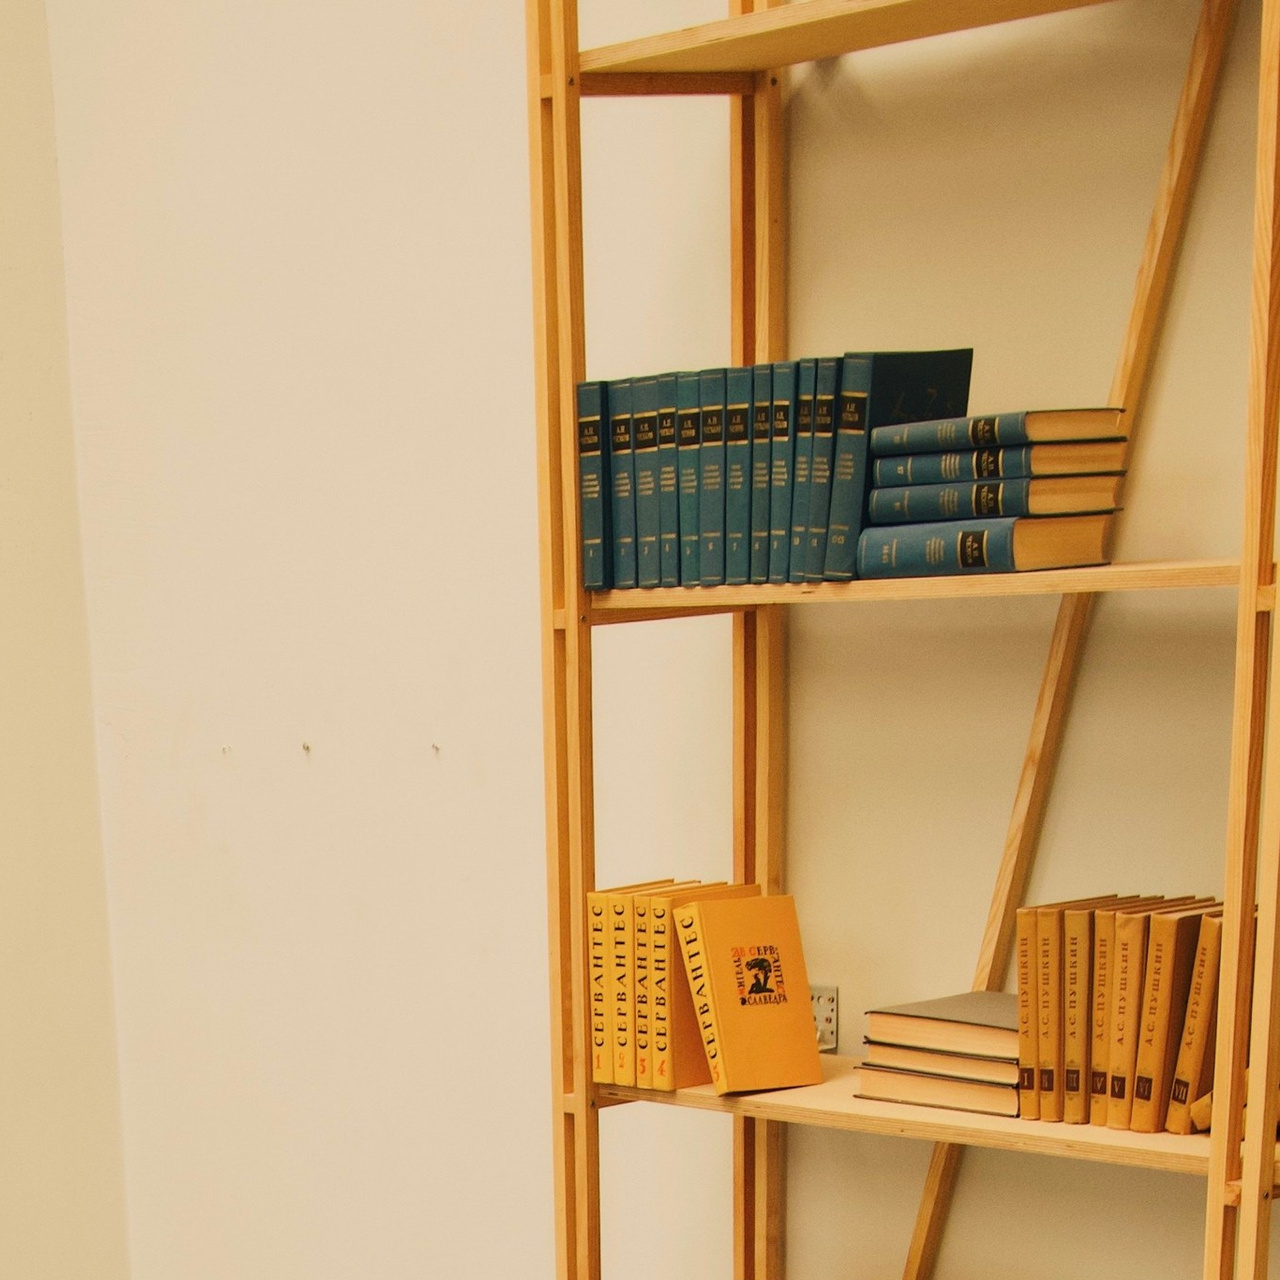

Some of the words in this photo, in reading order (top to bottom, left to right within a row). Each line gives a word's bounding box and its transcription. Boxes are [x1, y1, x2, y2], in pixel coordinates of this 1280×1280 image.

[592, 905, 604, 1047] СЕРВАНТЕС
[613, 904, 627, 1047] СЕРВАНТЕС
[636, 905, 649, 1050] СЕРВАНТЕС
[653, 907, 667, 1052] СЕРВАНТЕС
[680, 916, 718, 1059] СЕРВАНТЕС
[1021, 937, 1029, 1008] ПУШКИН
[1042, 938, 1050, 1009] ПУШКИН
[1069, 936, 1078, 1009] ПУШКИН
[1097, 938, 1107, 1011] ПУШКИН
[1118, 942, 1129, 1015] ПУШКИН
[1149, 943, 1163, 1016] ПУШКИН
[1191, 946, 1207, 1021] ПУШКИН
[595, 1054, 601, 1069] 1
[618, 1052, 625, 1068] 2
[638, 1058, 646, 1075] 3
[657, 1059, 666, 1077] 4
